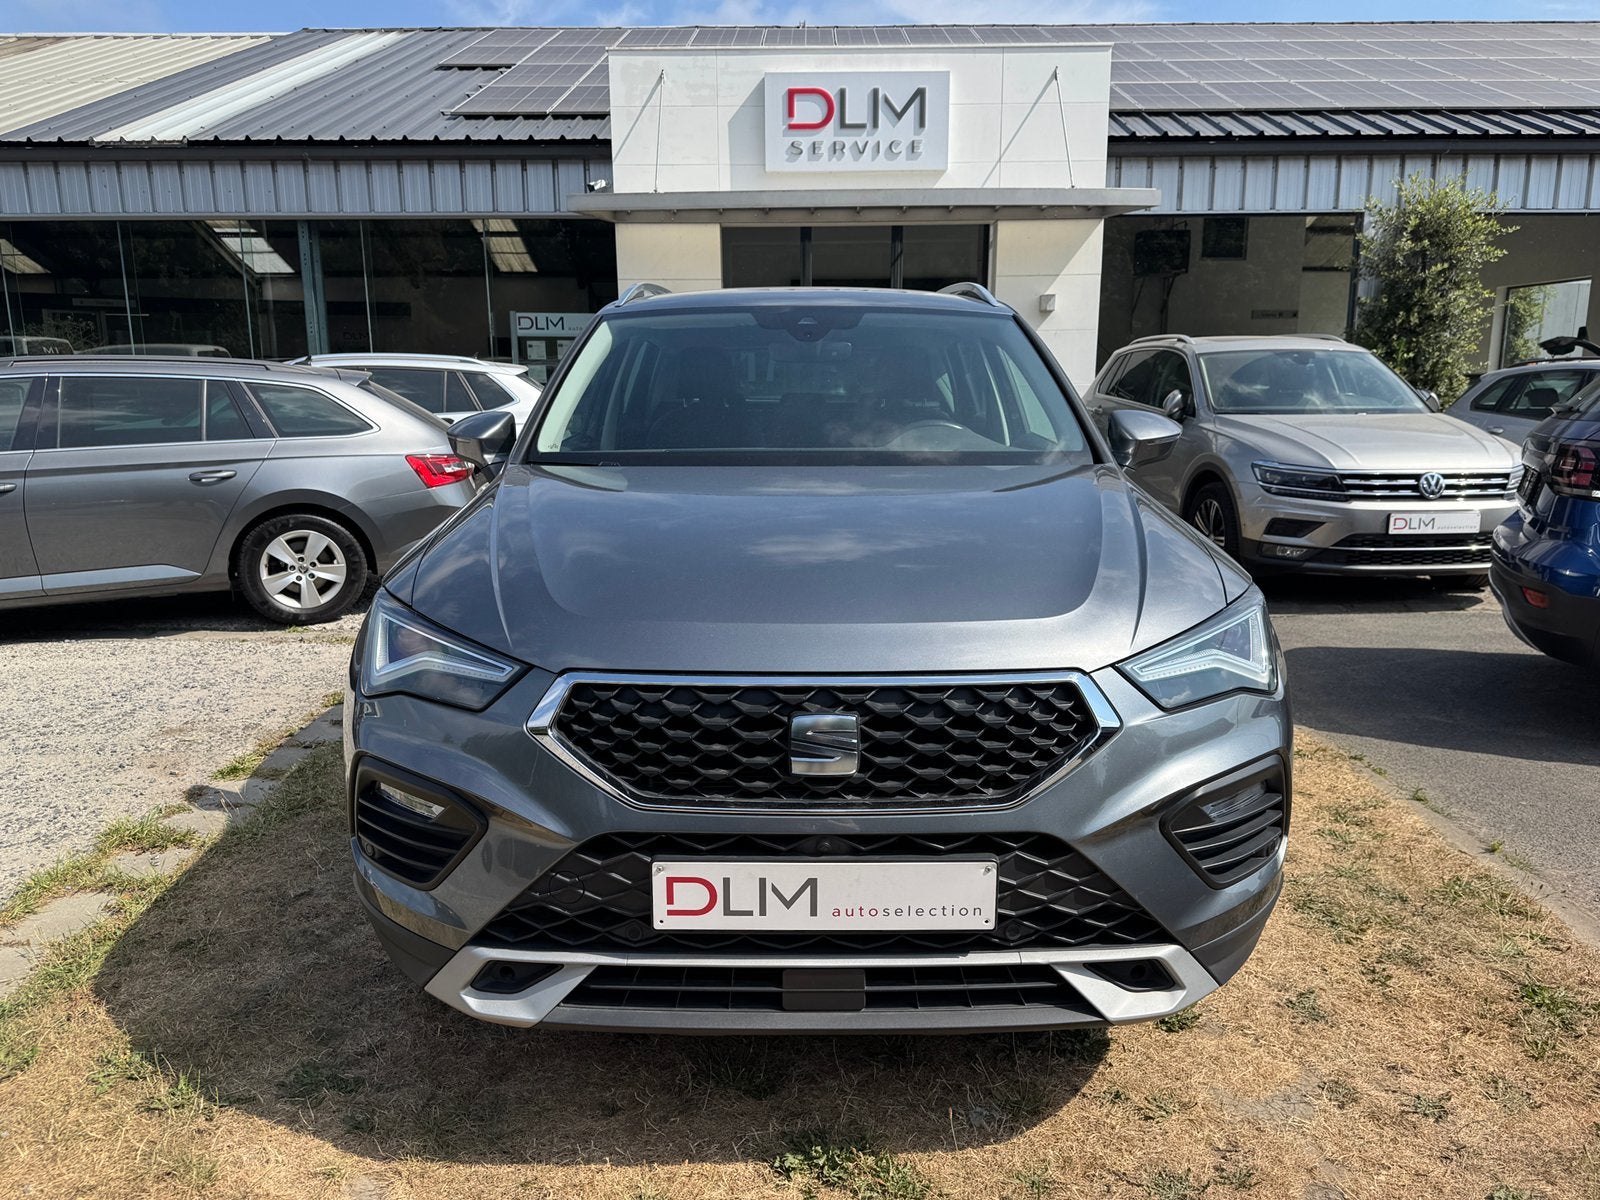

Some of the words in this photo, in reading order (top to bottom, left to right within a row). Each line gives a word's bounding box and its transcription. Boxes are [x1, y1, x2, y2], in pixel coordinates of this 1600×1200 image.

[787, 87, 927, 130] DLM
[790, 139, 924, 156] SERVICE
[518, 316, 565, 331] DLM
[1393, 517, 1435, 530] DLM
[665, 876, 818, 917] DLM
[832, 904, 982, 917] autoselection
